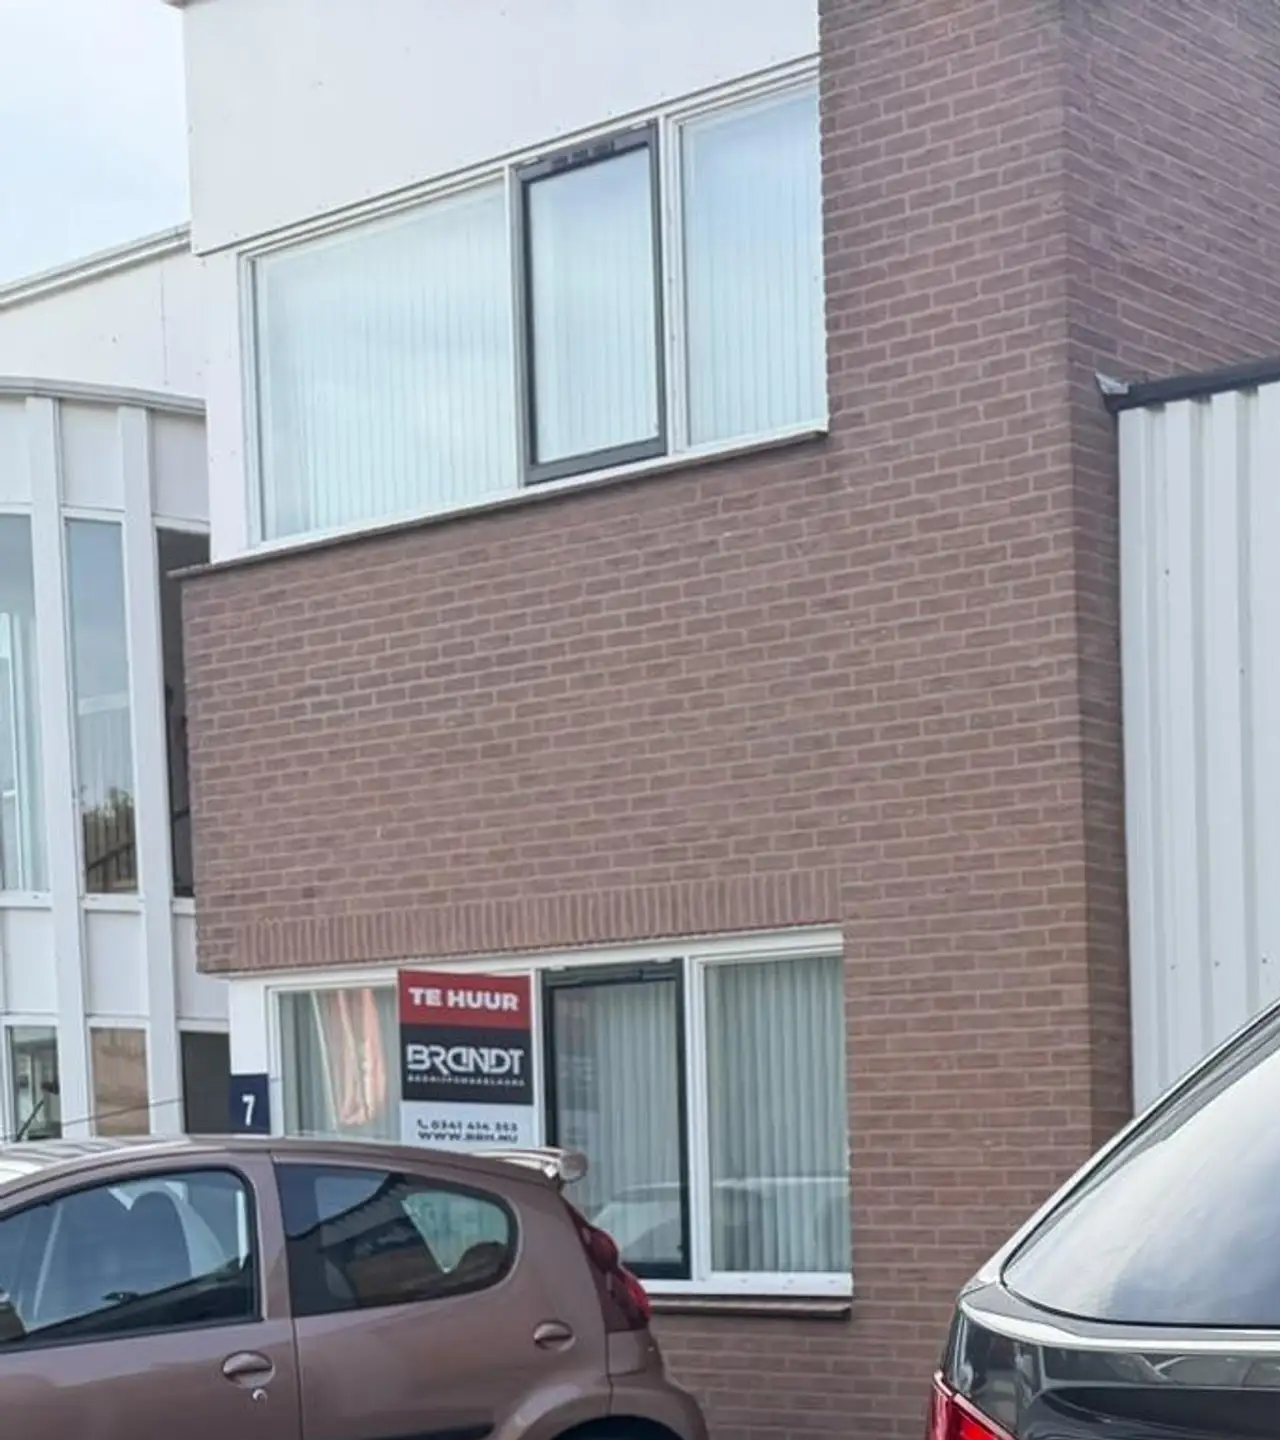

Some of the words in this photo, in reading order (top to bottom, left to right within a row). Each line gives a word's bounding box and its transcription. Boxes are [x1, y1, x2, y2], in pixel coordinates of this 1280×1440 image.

[408, 986, 443, 1007] TE
[447, 988, 519, 1011] HUUR
[406, 1043, 525, 1075] BRANDT
[242, 1093, 256, 1127] 7
